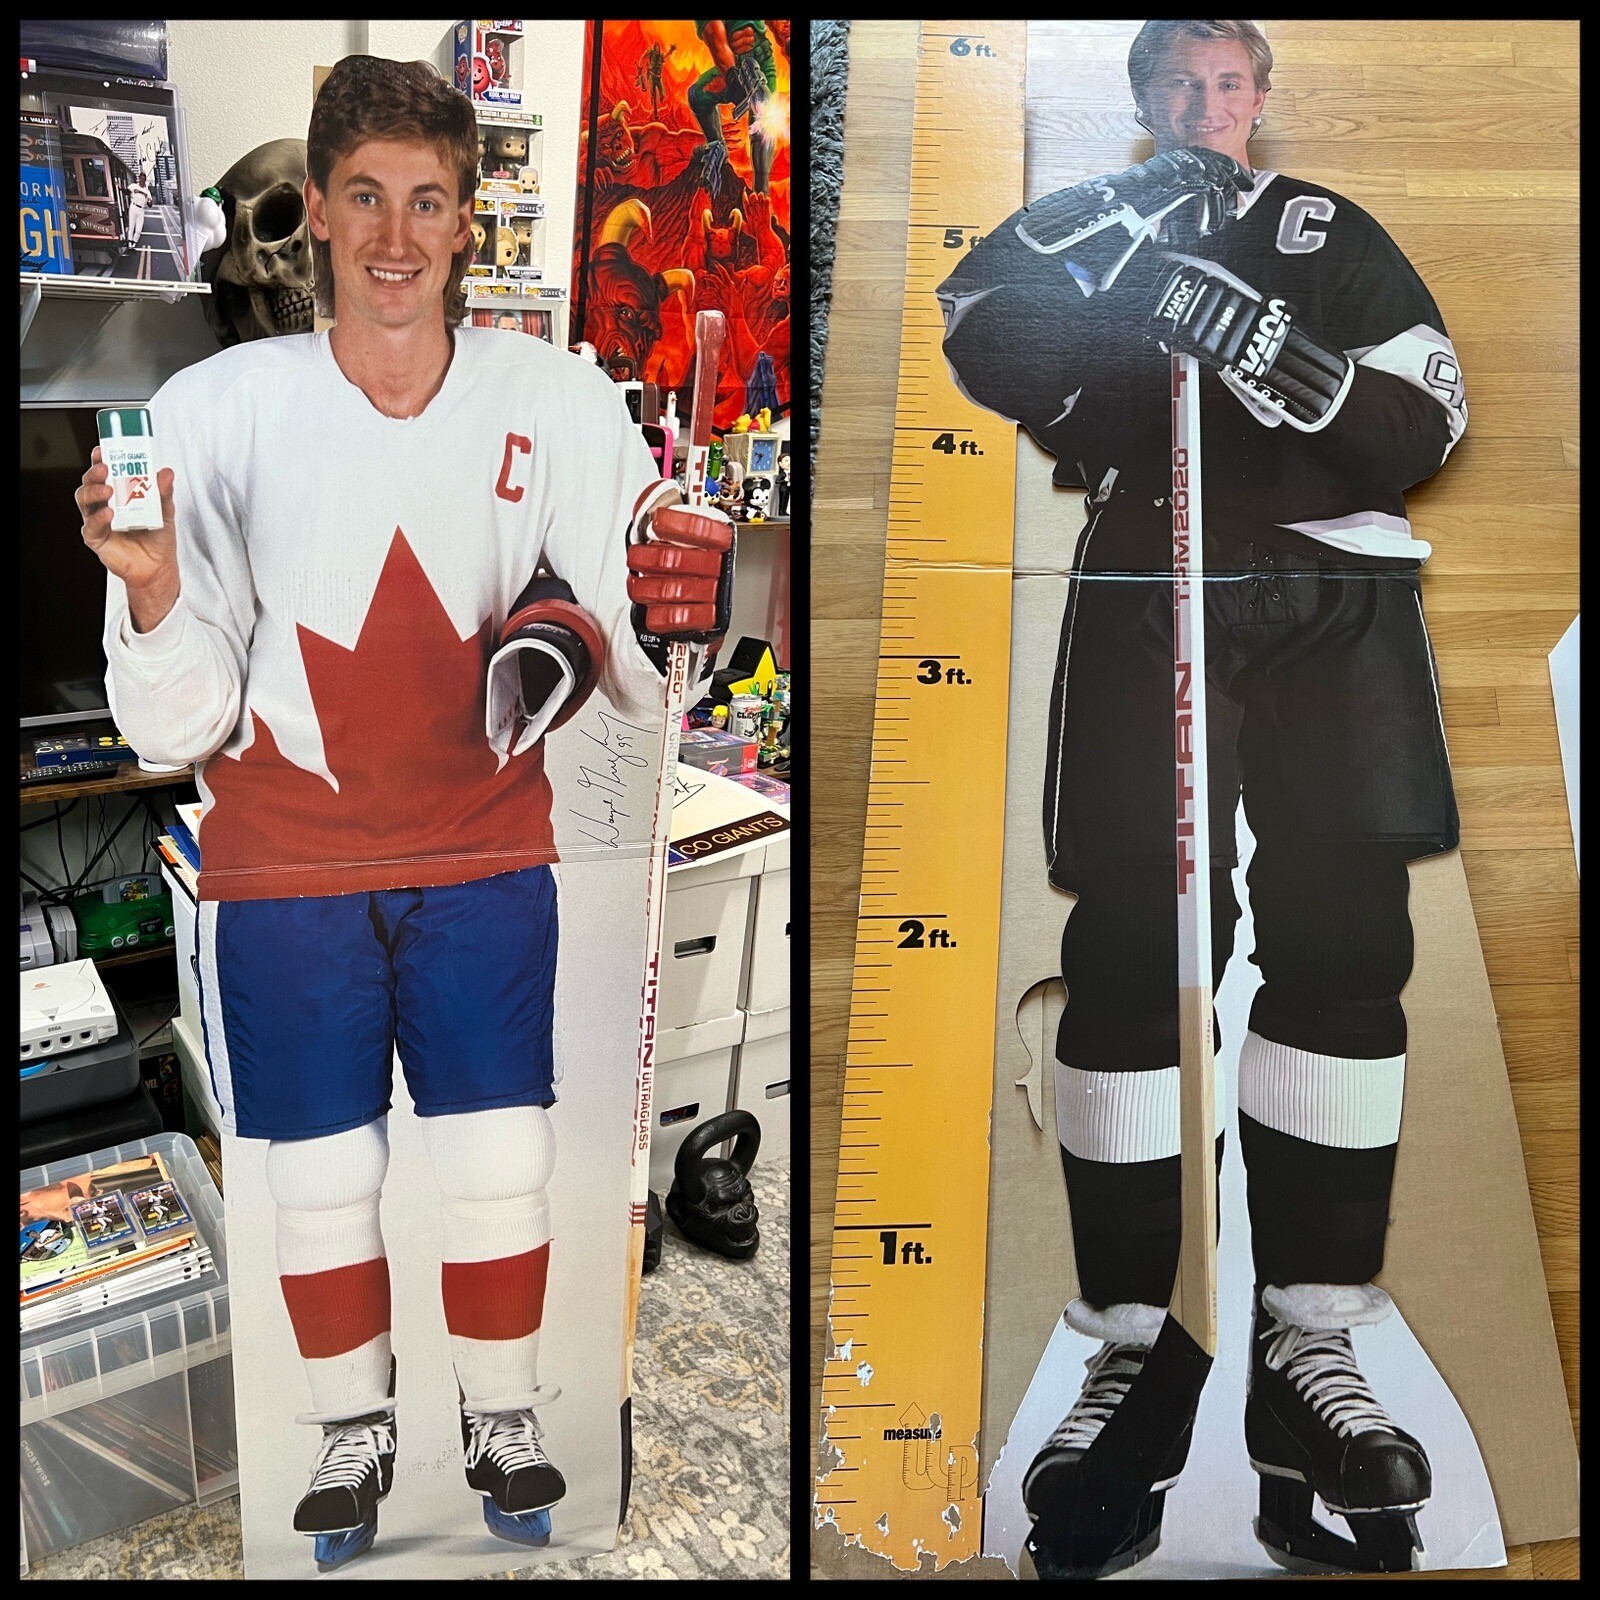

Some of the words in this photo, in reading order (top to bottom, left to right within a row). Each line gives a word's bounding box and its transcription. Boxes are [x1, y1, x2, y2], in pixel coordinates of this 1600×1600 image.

[950, 38, 971, 57] 6
[976, 44, 997, 58] ft.
[30, 116, 53, 125] VALLEY
[82, 220, 110, 233] Streets
[943, 229, 964, 249] 5
[1276, 195, 1337, 255] C
[1164, 280, 1193, 321] JOFA
[1239, 299, 1292, 377] JOFA
[127, 452, 147, 460] GUARD
[932, 433, 957, 455] 4
[960, 441, 984, 456] ft.
[111, 461, 149, 477] SPORT
[495, 432, 532, 503] C
[917, 660, 942, 685] 3
[946, 668, 972, 685] ft.
[664, 733, 680, 789] GRETZKY
[1175, 662, 1195, 895] TITAN
[711, 816, 784, 845] GIANTS
[897, 919, 925, 949] 2
[928, 929, 957, 949] ft.
[643, 952, 659, 1068] TITAN
[48, 1025, 62, 1033] SEGA
[638, 1072, 653, 1151] ULTRAGLASS
[880, 1231, 898, 1265] 1
[901, 1241, 932, 1264] ft.
[21, 1440, 51, 1487] GHOSTWIRE
